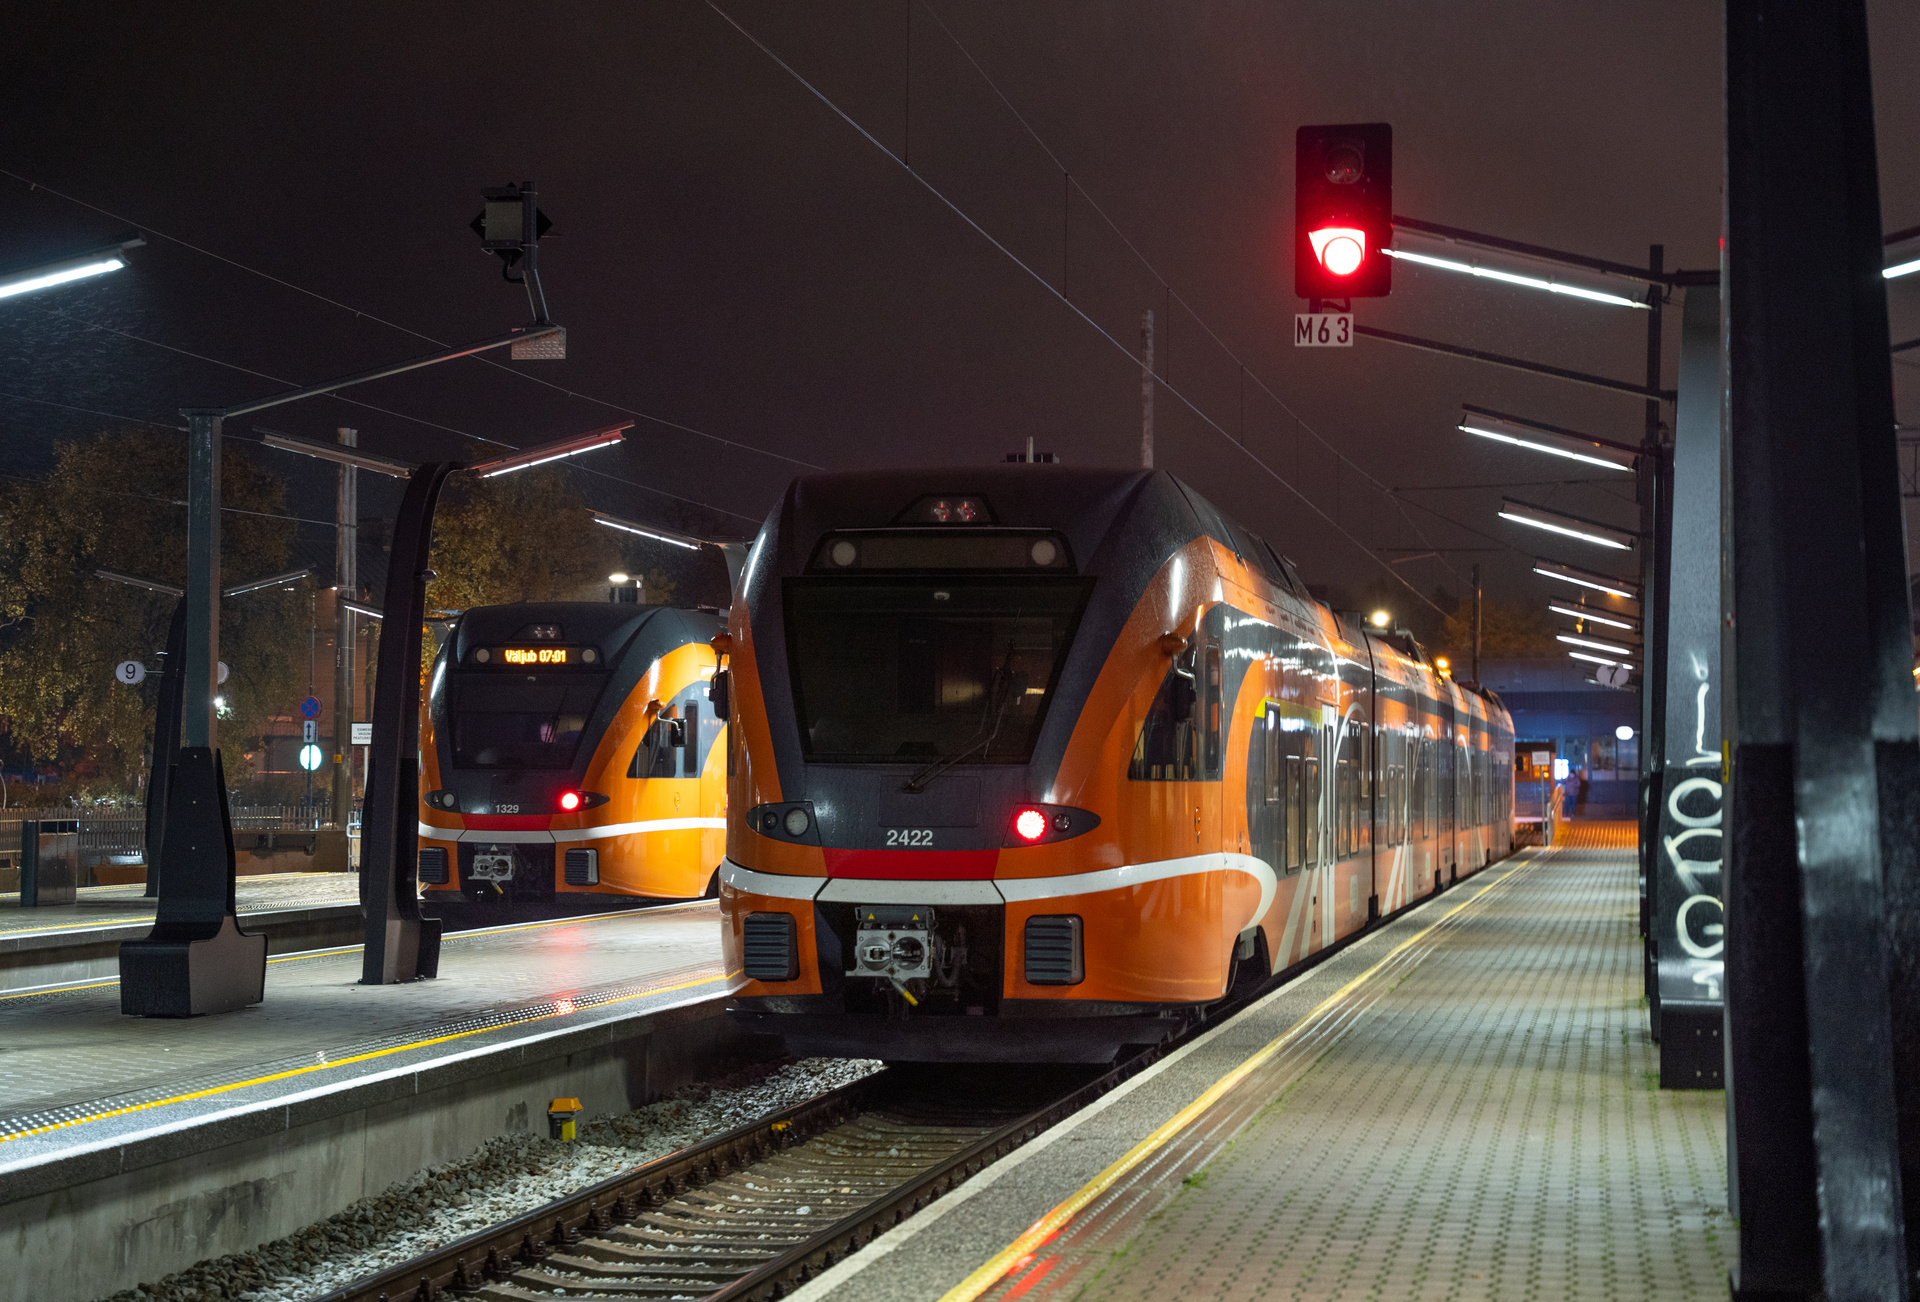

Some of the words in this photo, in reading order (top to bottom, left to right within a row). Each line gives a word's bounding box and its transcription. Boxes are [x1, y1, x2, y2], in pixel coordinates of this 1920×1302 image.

[1297, 317, 1349, 343] M63
[505, 649, 537, 664] Väljub
[539, 649, 566, 663] 07:01
[125, 663, 136, 679] 9
[1607, 666, 1618, 683] 7
[495, 804, 519, 814] 1329
[886, 829, 933, 846] 2422
